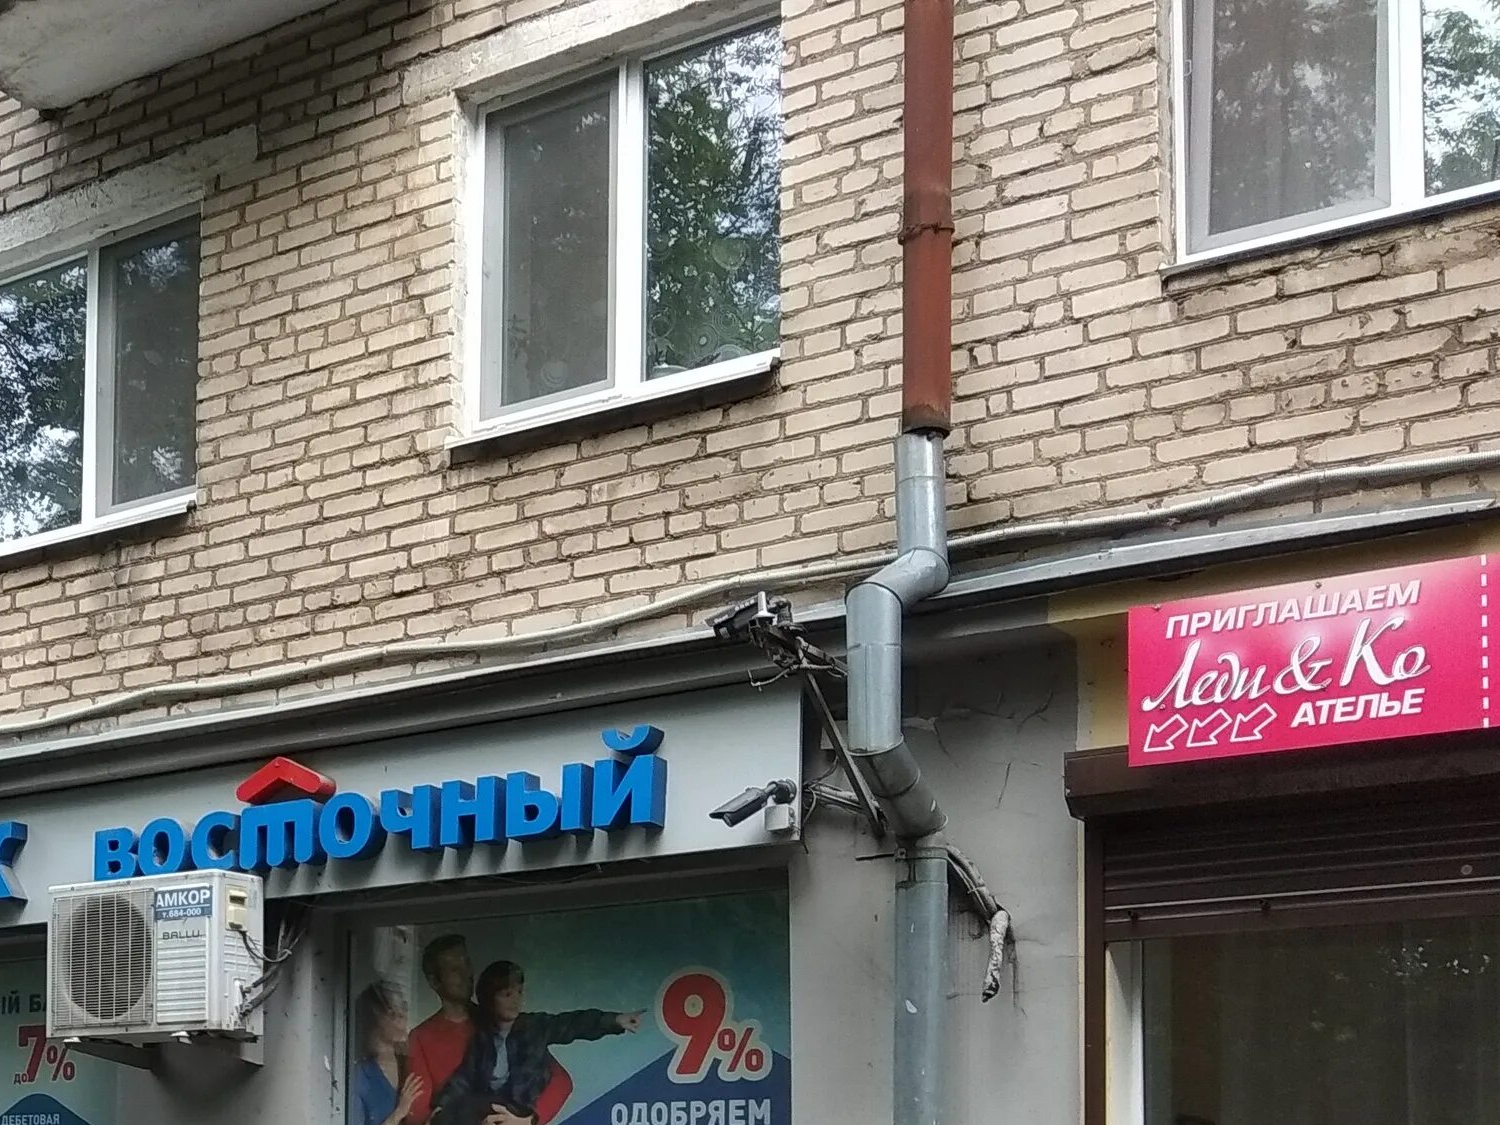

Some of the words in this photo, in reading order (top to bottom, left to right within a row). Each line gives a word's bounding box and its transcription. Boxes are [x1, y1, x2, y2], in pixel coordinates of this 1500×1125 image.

[1165, 579, 1421, 639] ПРИГЛАШАЕМ
[1272, 635, 1333, 692] &
[1290, 688, 1426, 728] АТЕЛЬЕ
[94, 725, 667, 881] ВОСТОЧНЫЙ
[155, 889, 211, 908] АМКОР
[659, 970, 767, 1078] 9%
